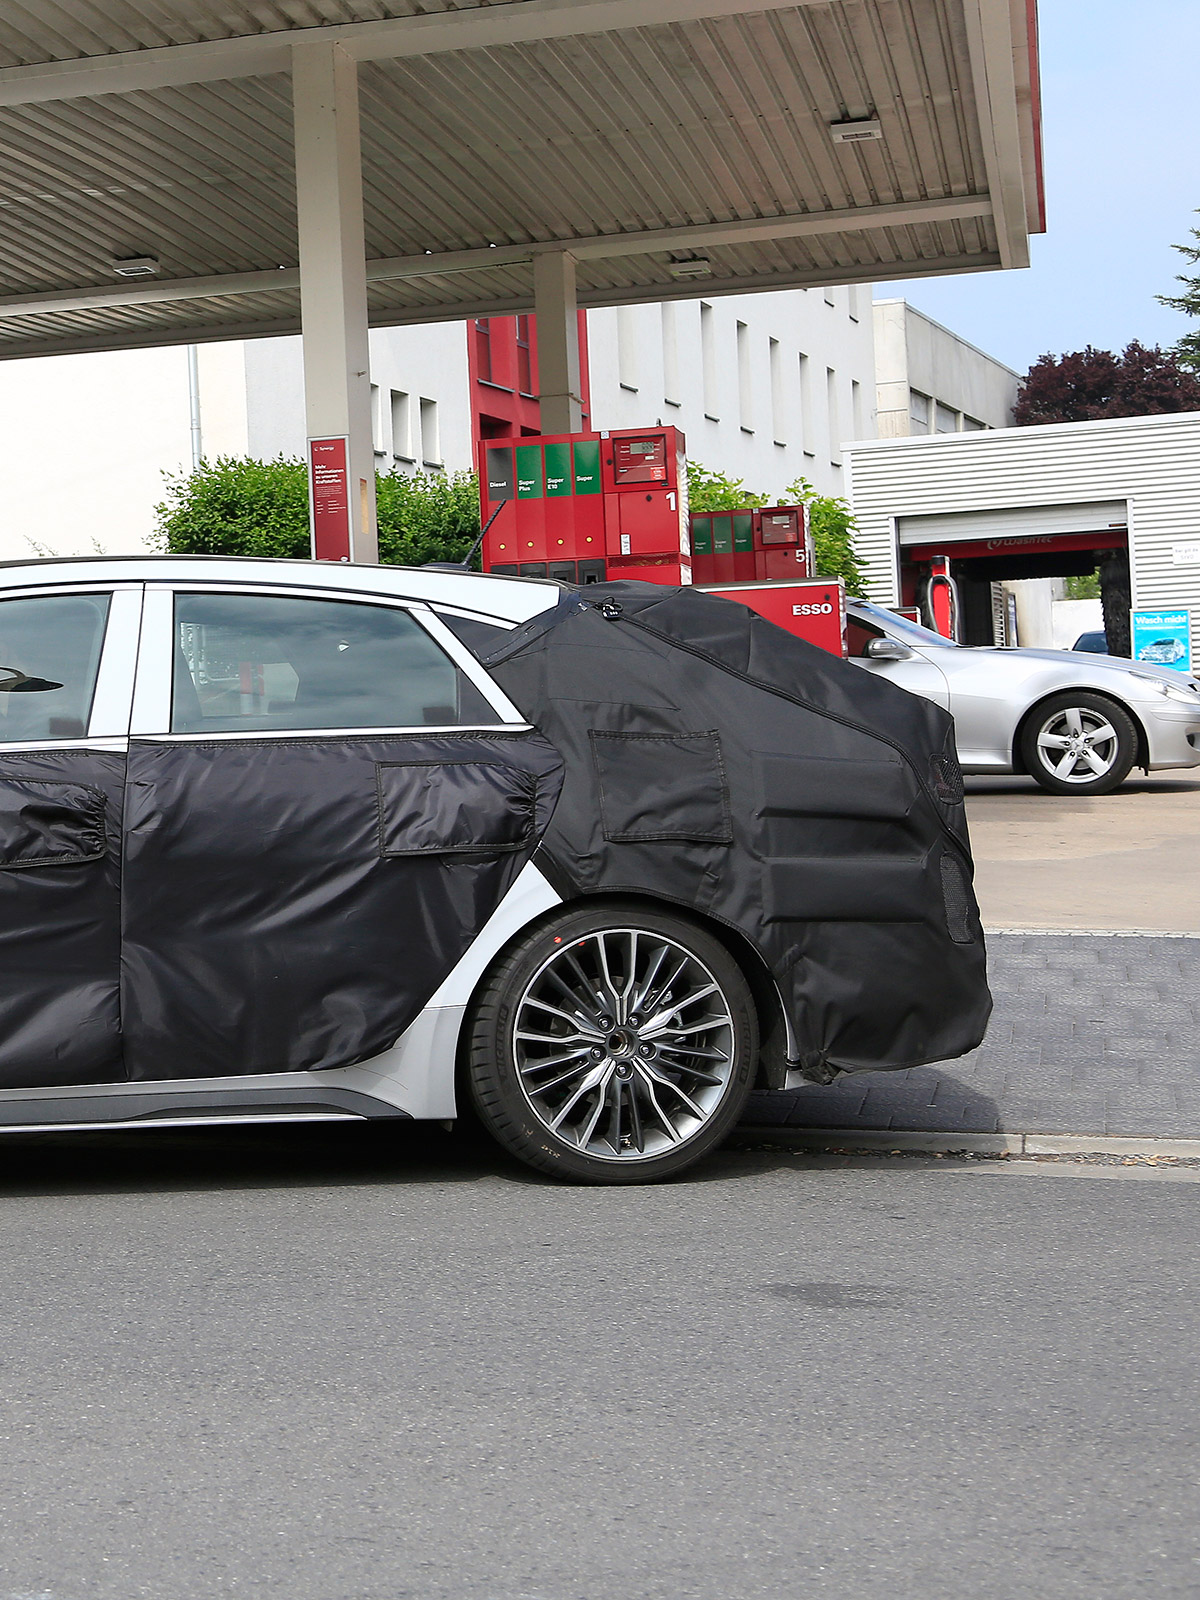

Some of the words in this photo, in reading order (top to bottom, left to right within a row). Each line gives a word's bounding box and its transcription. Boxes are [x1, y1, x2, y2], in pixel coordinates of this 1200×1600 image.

[547, 477, 564, 485] Super
[666, 492, 676, 511] 1
[796, 550, 806, 563] 5
[792, 603, 833, 616] ESSO
[1135, 616, 1163, 625] Wasch
